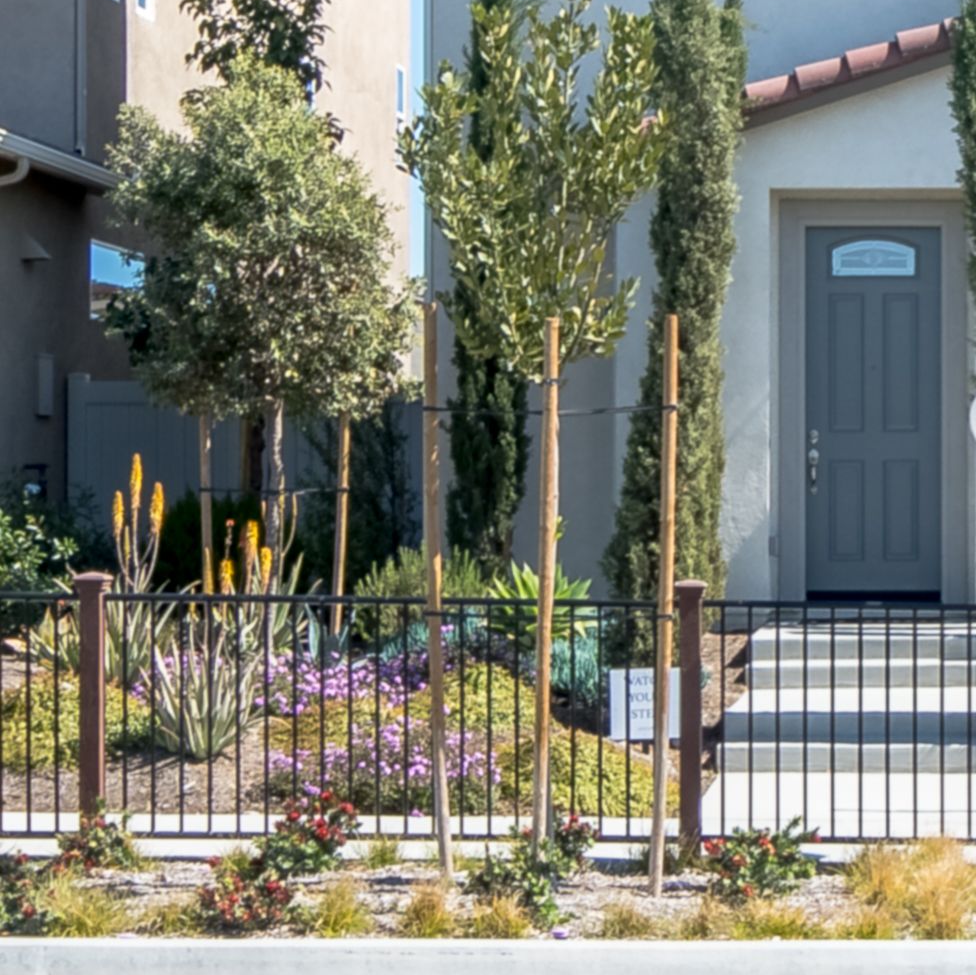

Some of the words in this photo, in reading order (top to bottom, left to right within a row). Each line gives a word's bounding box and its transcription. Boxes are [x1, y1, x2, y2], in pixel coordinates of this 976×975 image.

[624, 675, 655, 686] WAT
[627, 692, 654, 703] YOU
[631, 709, 654, 719] STE
